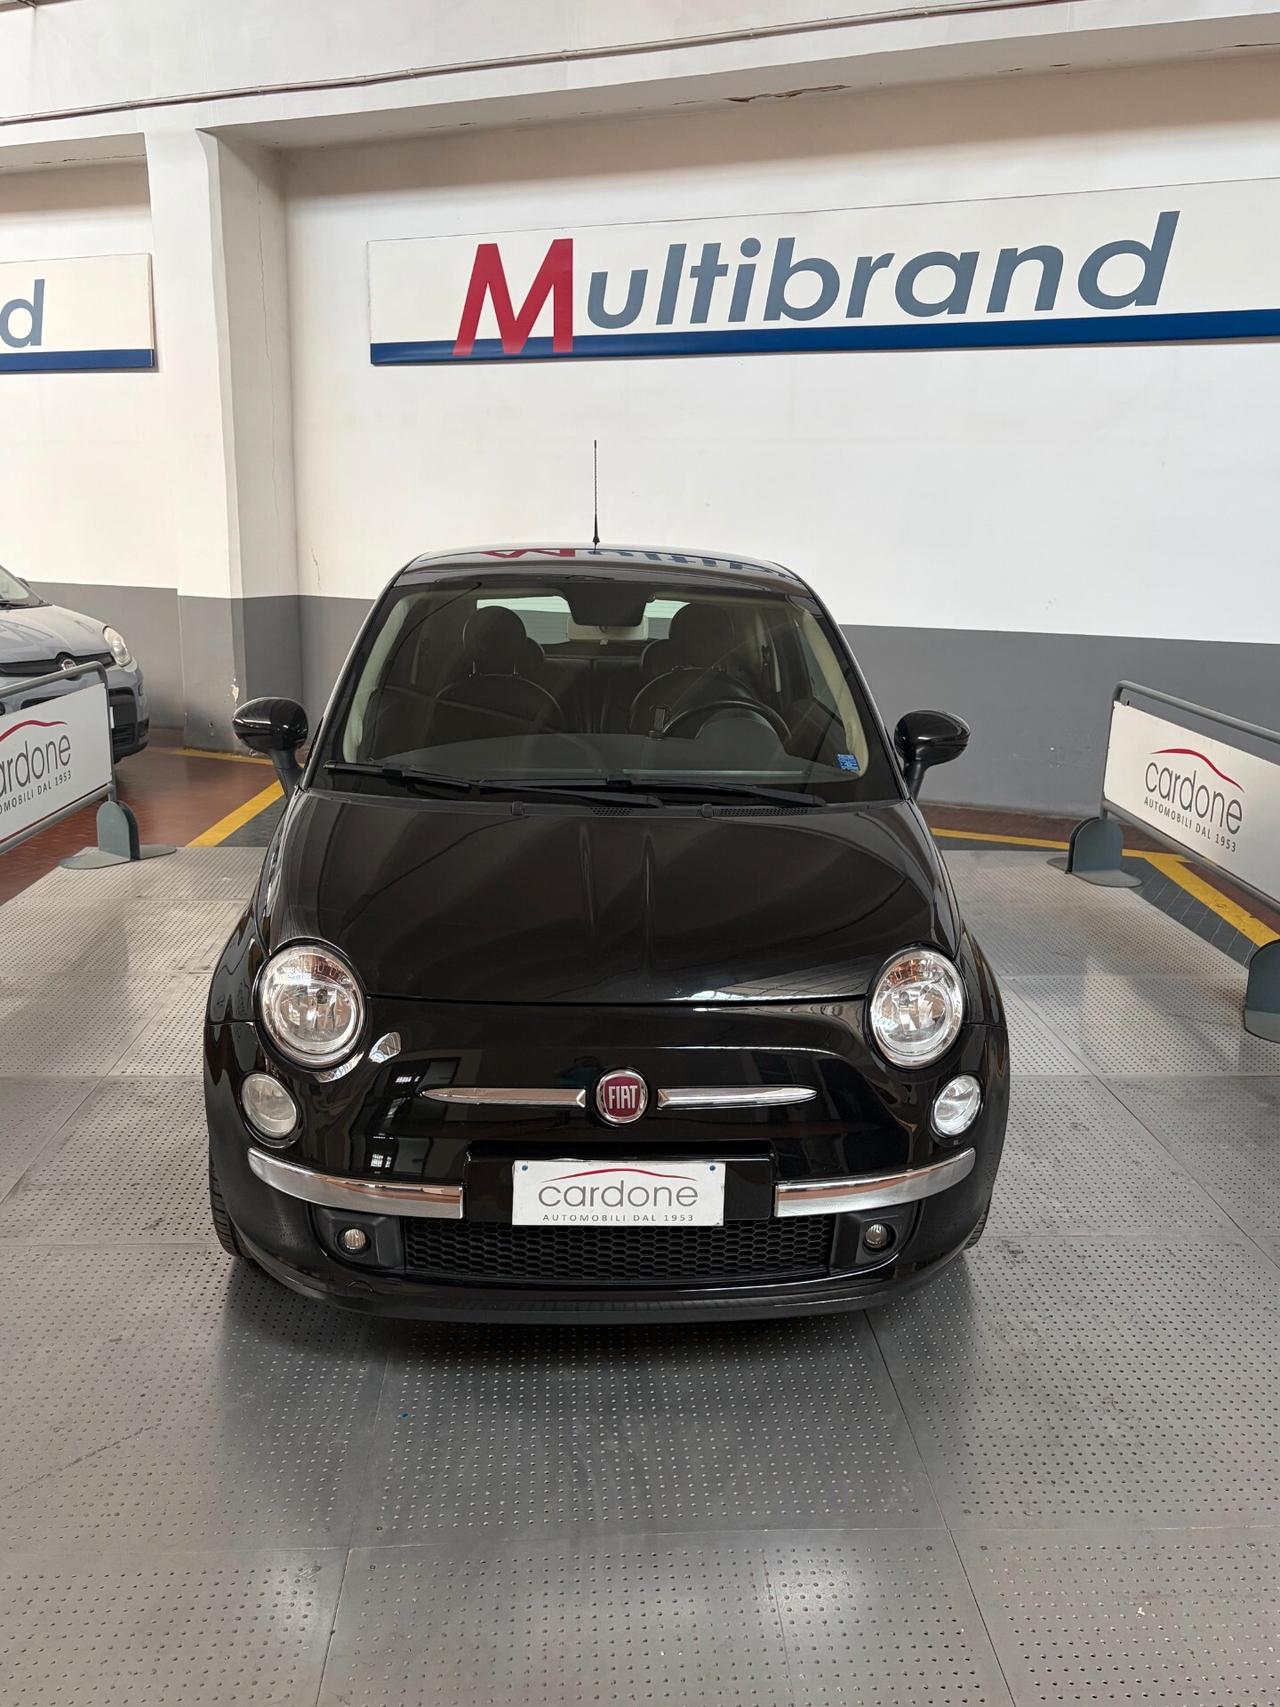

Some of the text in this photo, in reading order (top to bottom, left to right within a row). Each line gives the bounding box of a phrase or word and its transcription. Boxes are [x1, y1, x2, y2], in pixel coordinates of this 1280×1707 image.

[452, 210, 1181, 356] Multibrand
[37, 781, 52, 795] DAL
[55, 770, 71, 786] 1953
[1145, 762, 1242, 835] cardone
[1144, 797, 1236, 853] AUTOMOBILI DAL 1953
[608, 1085, 638, 1109] FIAT
[538, 1180, 699, 1207] cardone
[542, 1214, 694, 1222] AUTOMOBILI DAL 1953
